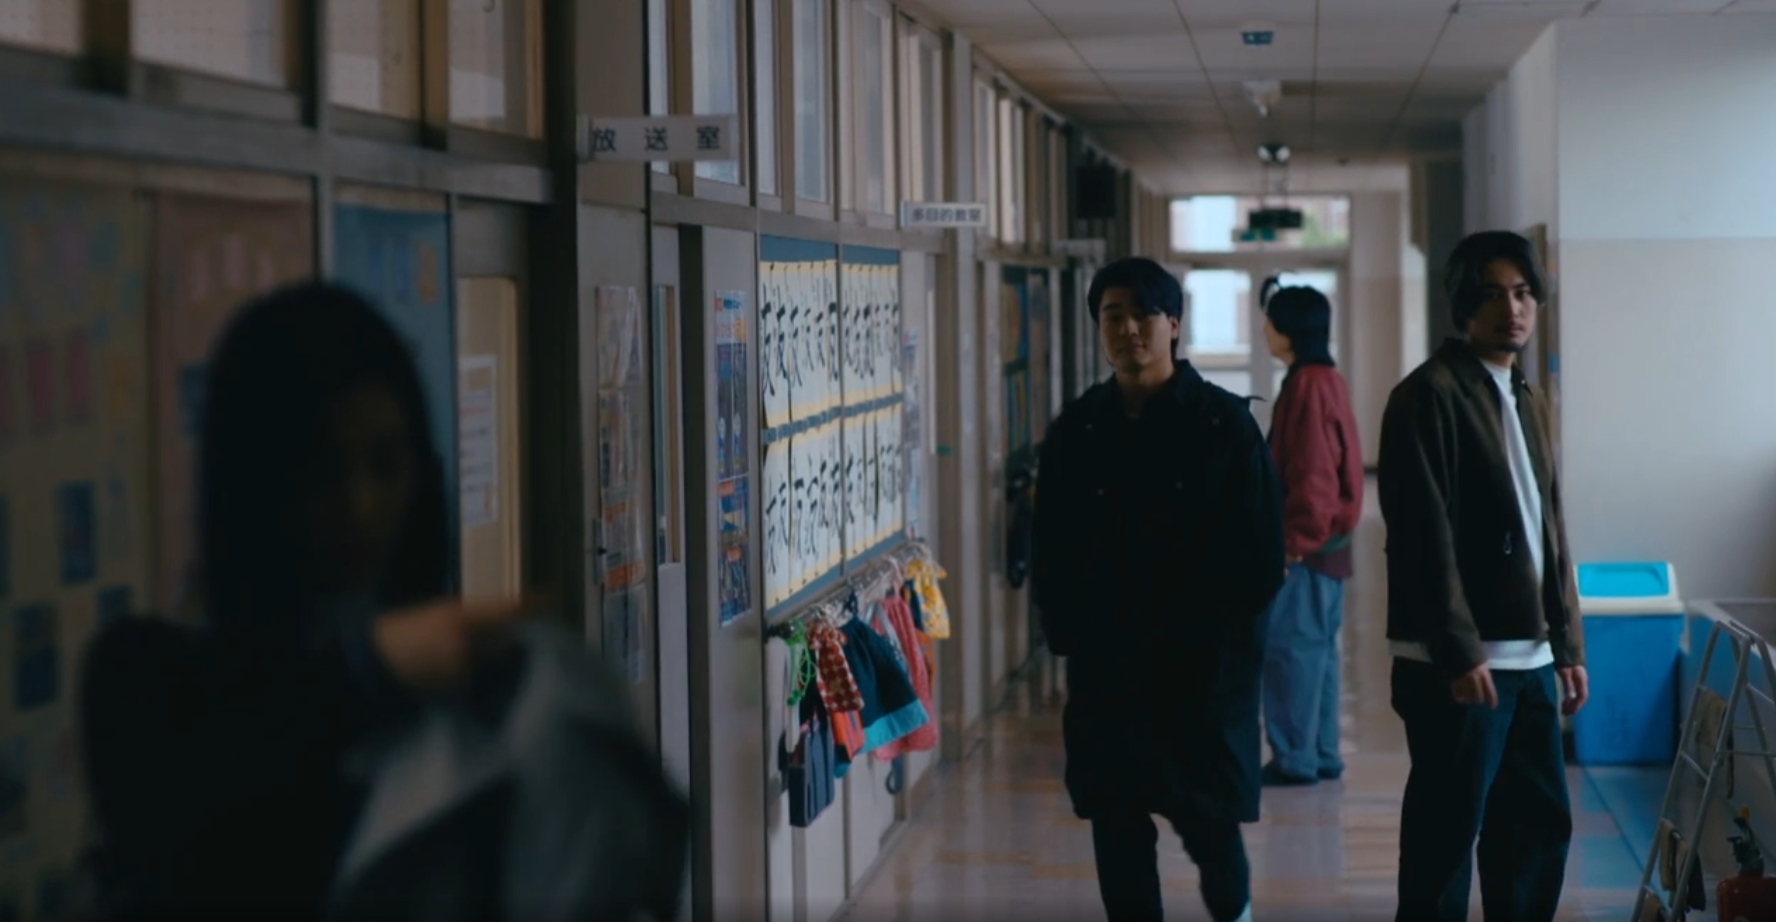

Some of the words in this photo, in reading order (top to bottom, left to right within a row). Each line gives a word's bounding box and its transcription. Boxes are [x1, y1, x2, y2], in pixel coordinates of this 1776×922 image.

[591, 125, 721, 152] 放送室
[911, 206, 982, 223] 多目的教室
